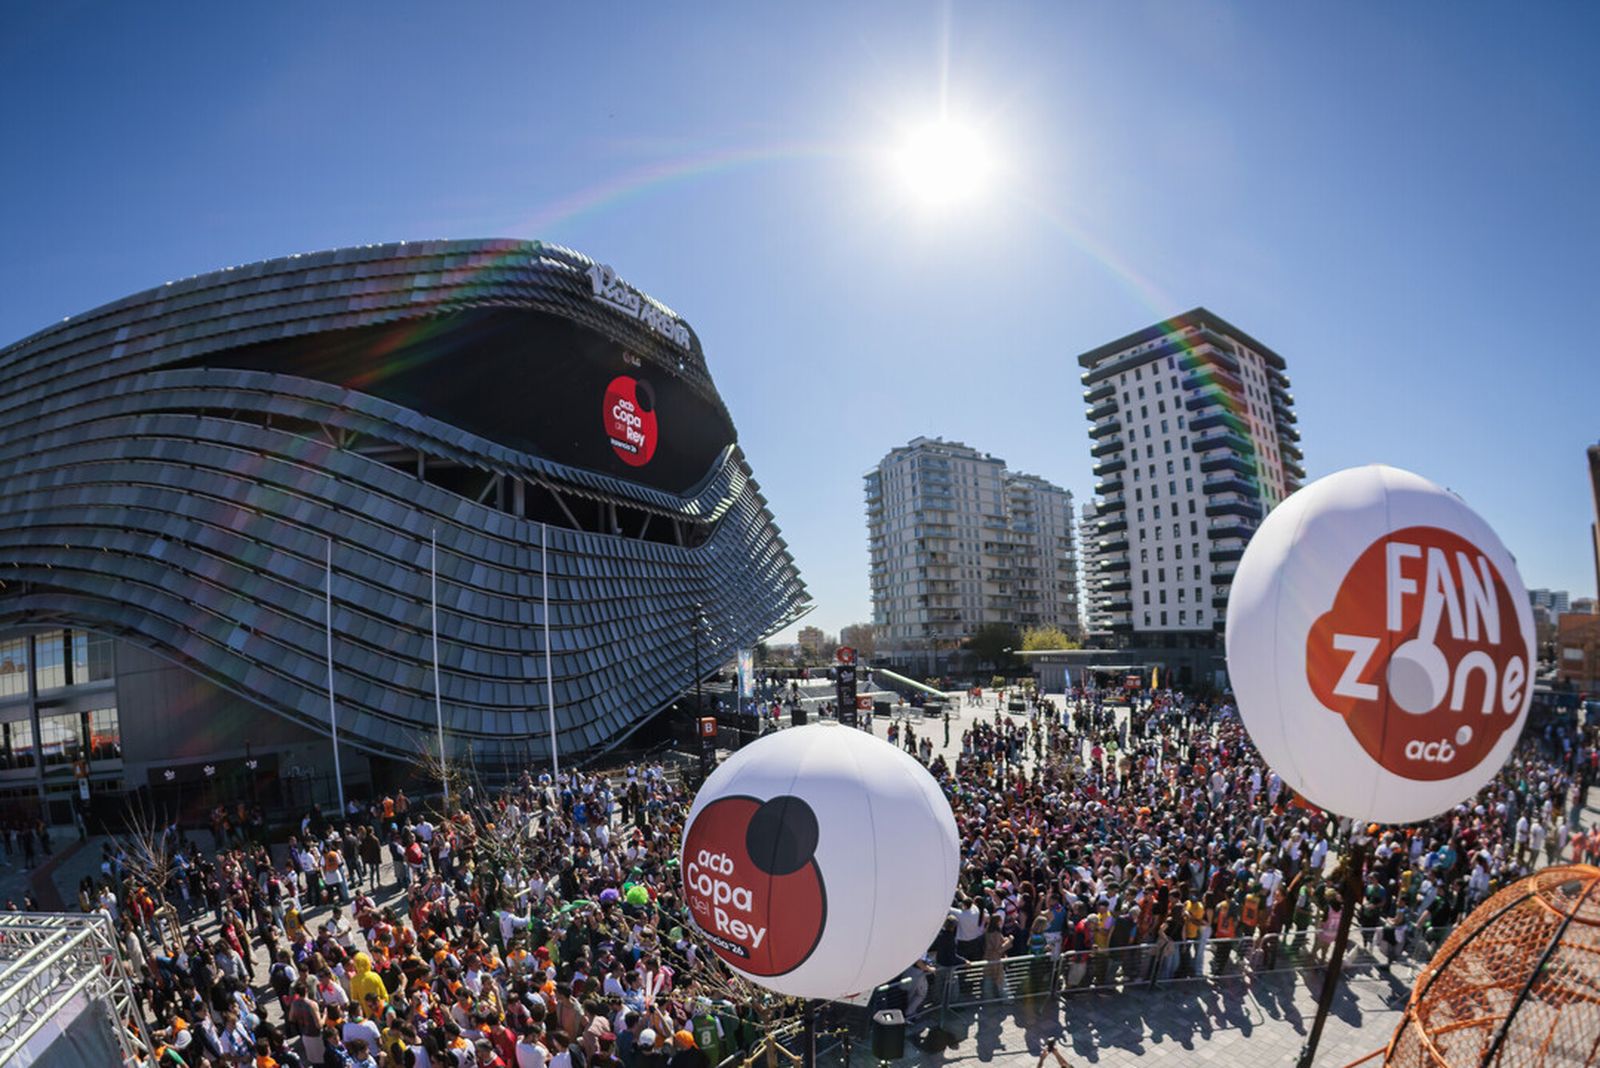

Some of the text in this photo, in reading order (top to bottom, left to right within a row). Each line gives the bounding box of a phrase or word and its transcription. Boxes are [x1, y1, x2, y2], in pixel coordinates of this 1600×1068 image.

[612, 404, 642, 428] Copa
[626, 426, 646, 447] Rey
[1386, 542, 1501, 645] FAN
[704, 722, 713, 733] B
[1405, 738, 1456, 763] acb
[698, 850, 734, 876] acb
[687, 862, 752, 913] Copa
[714, 906, 766, 949] Rey
